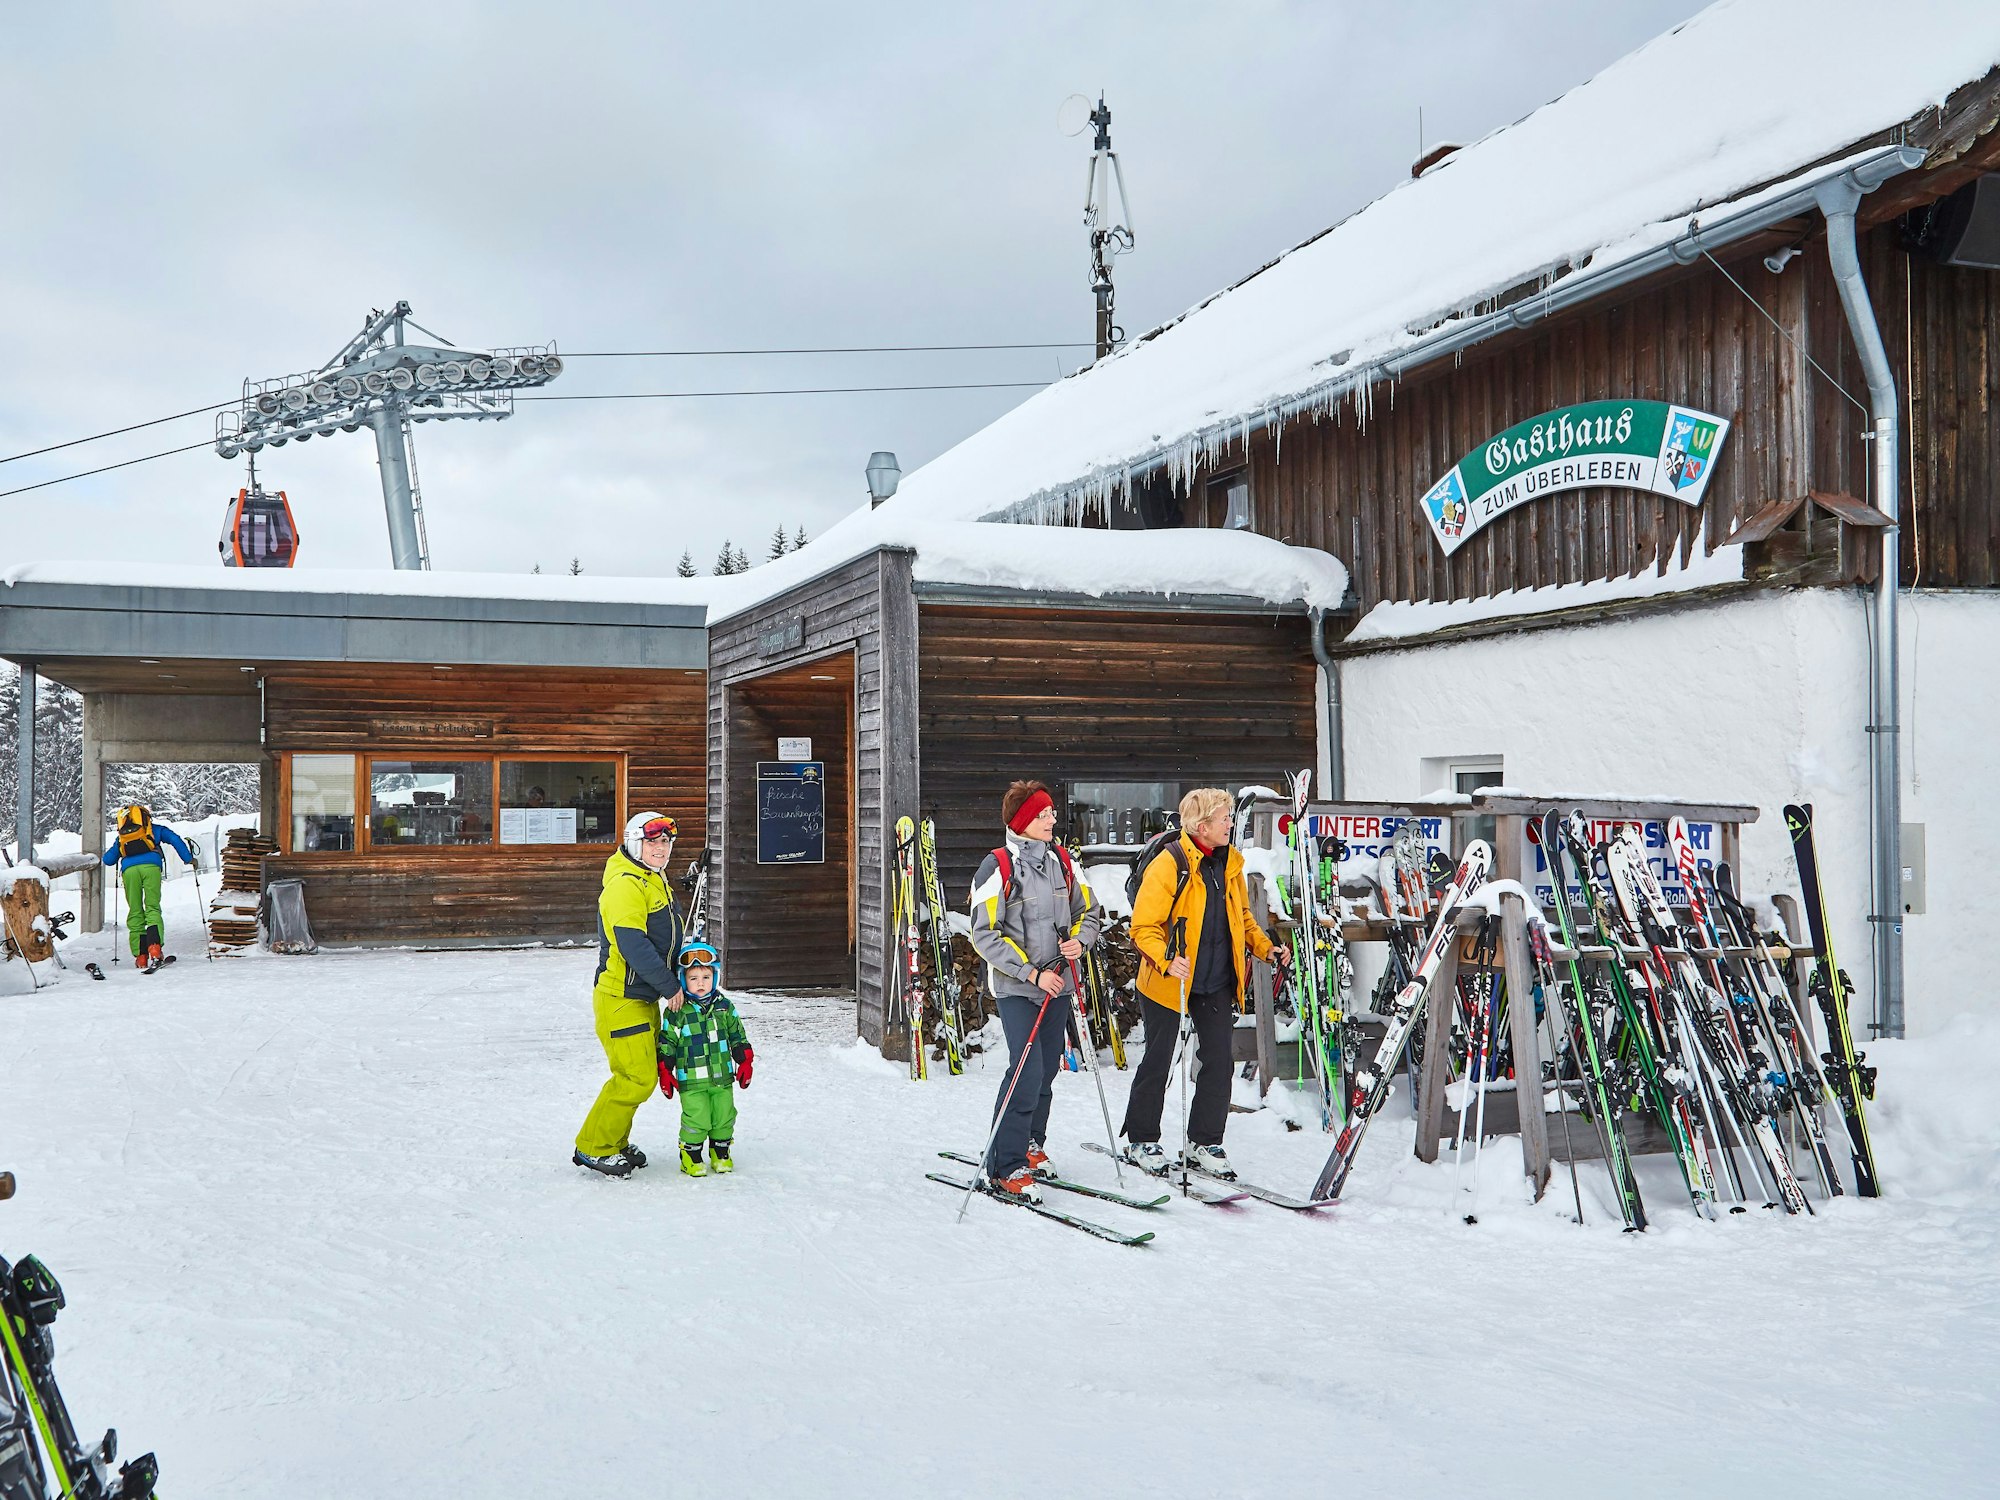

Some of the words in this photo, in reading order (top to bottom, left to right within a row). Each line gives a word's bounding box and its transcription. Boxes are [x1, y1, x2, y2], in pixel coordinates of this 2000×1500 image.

[1485, 407, 1634, 476] Gasthaus
[1482, 483, 1519, 516] ZUM
[1526, 461, 1641, 494] ÜBERLEBEN
[920, 819, 939, 905] FISCHER
